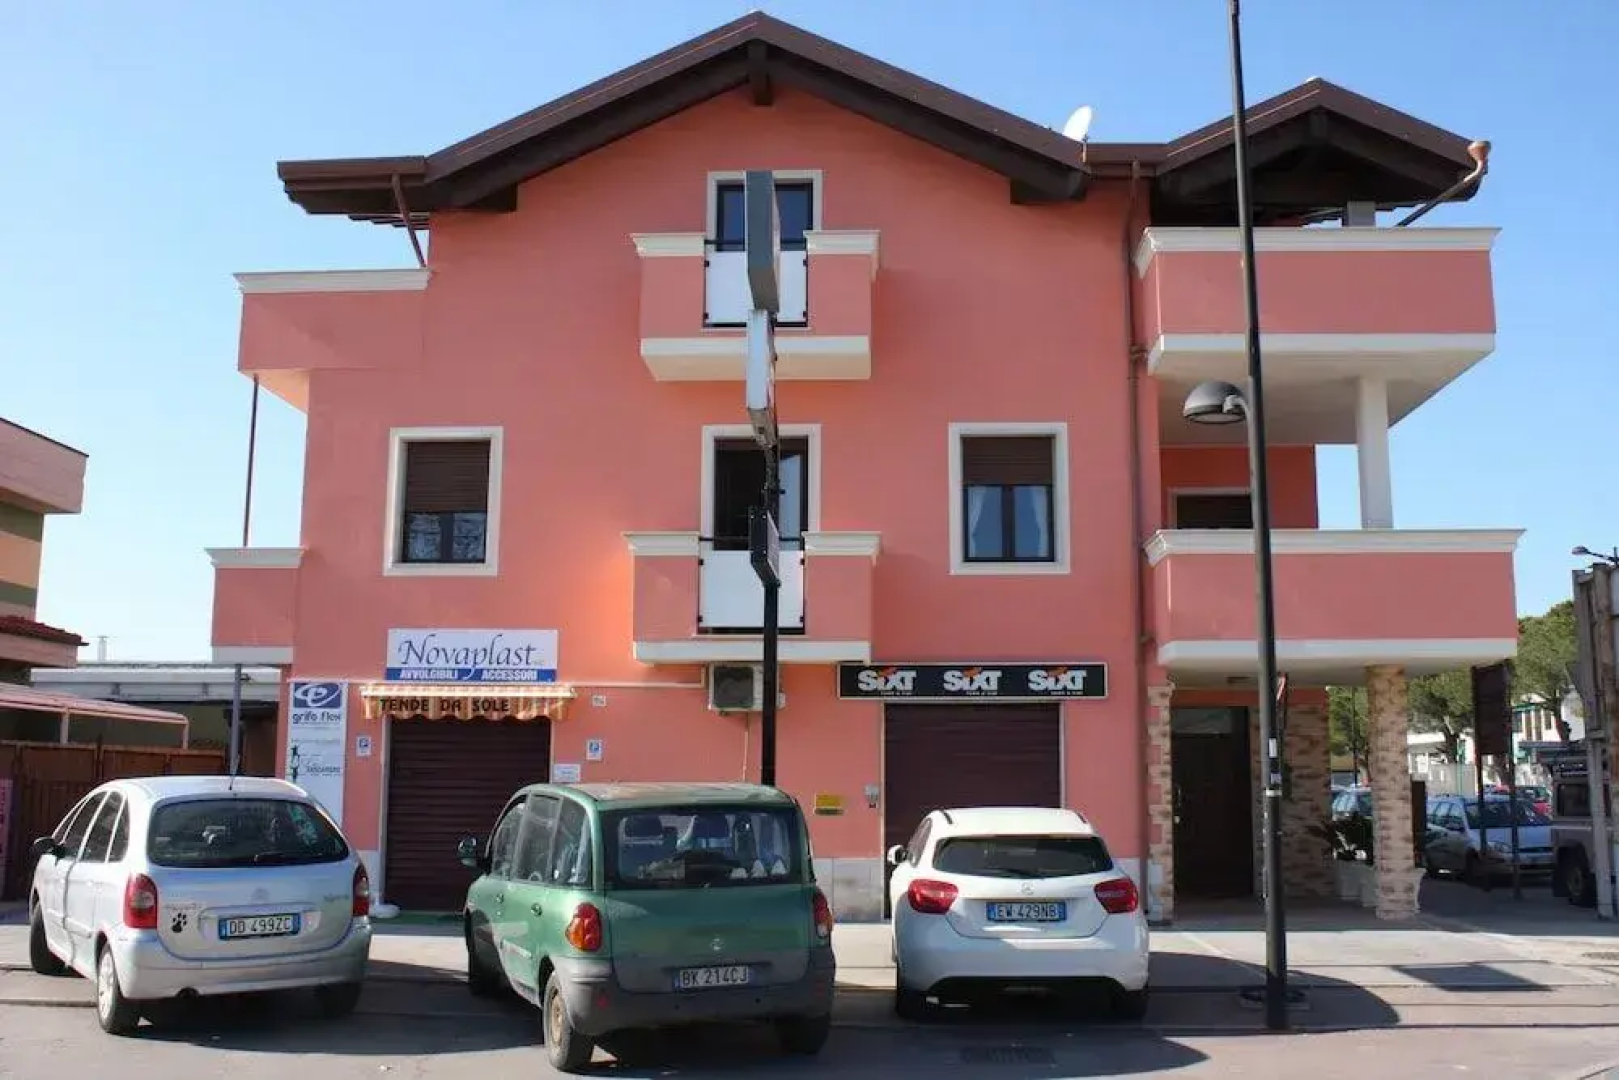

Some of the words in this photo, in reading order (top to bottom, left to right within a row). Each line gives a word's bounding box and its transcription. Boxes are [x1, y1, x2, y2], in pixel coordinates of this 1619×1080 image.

[398, 634, 538, 680] Novaplast
[400, 669, 459, 680] AVVOLGIBILI
[481, 669, 537, 681] ACCESSORI
[381, 699, 429, 712] TENDE
[440, 700, 461, 712] DA
[472, 699, 510, 712] SOLE
[998, 905, 1013, 918] EW
[229, 920, 246, 934] DD
